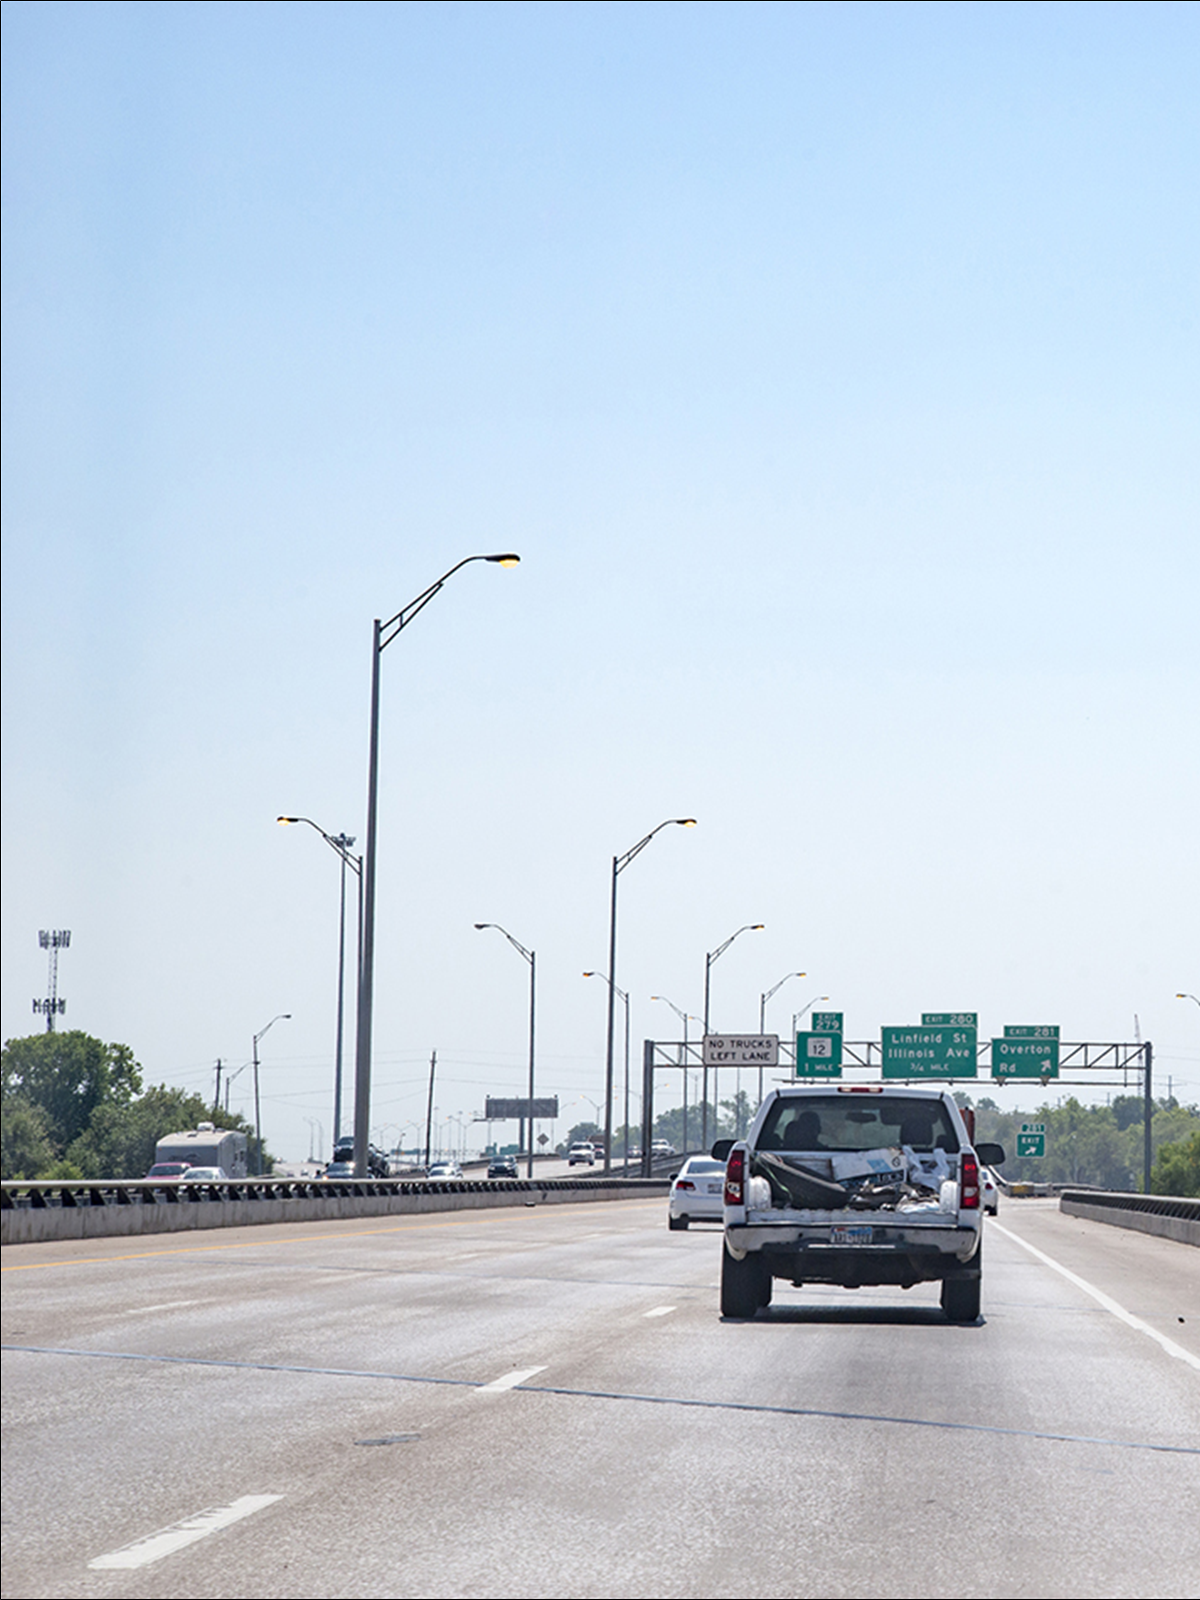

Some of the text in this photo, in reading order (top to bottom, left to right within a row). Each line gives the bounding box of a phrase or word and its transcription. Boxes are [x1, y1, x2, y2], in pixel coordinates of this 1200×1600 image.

[950, 1014, 973, 1024] 280
[816, 1020, 839, 1030] 279
[1034, 1027, 1055, 1037] 281
[892, 1033, 967, 1044] Linfield St
[709, 1040, 772, 1048] NO TRUCKS
[813, 1045, 825, 1055] 12
[888, 1048, 970, 1058] Illinois Ave
[1000, 1044, 1051, 1055] Overton
[711, 1052, 771, 1061] LEFT LANE
[804, 1063, 809, 1071] 1
[930, 1063, 949, 1071] MILE
[1000, 1063, 1016, 1073] Rd
